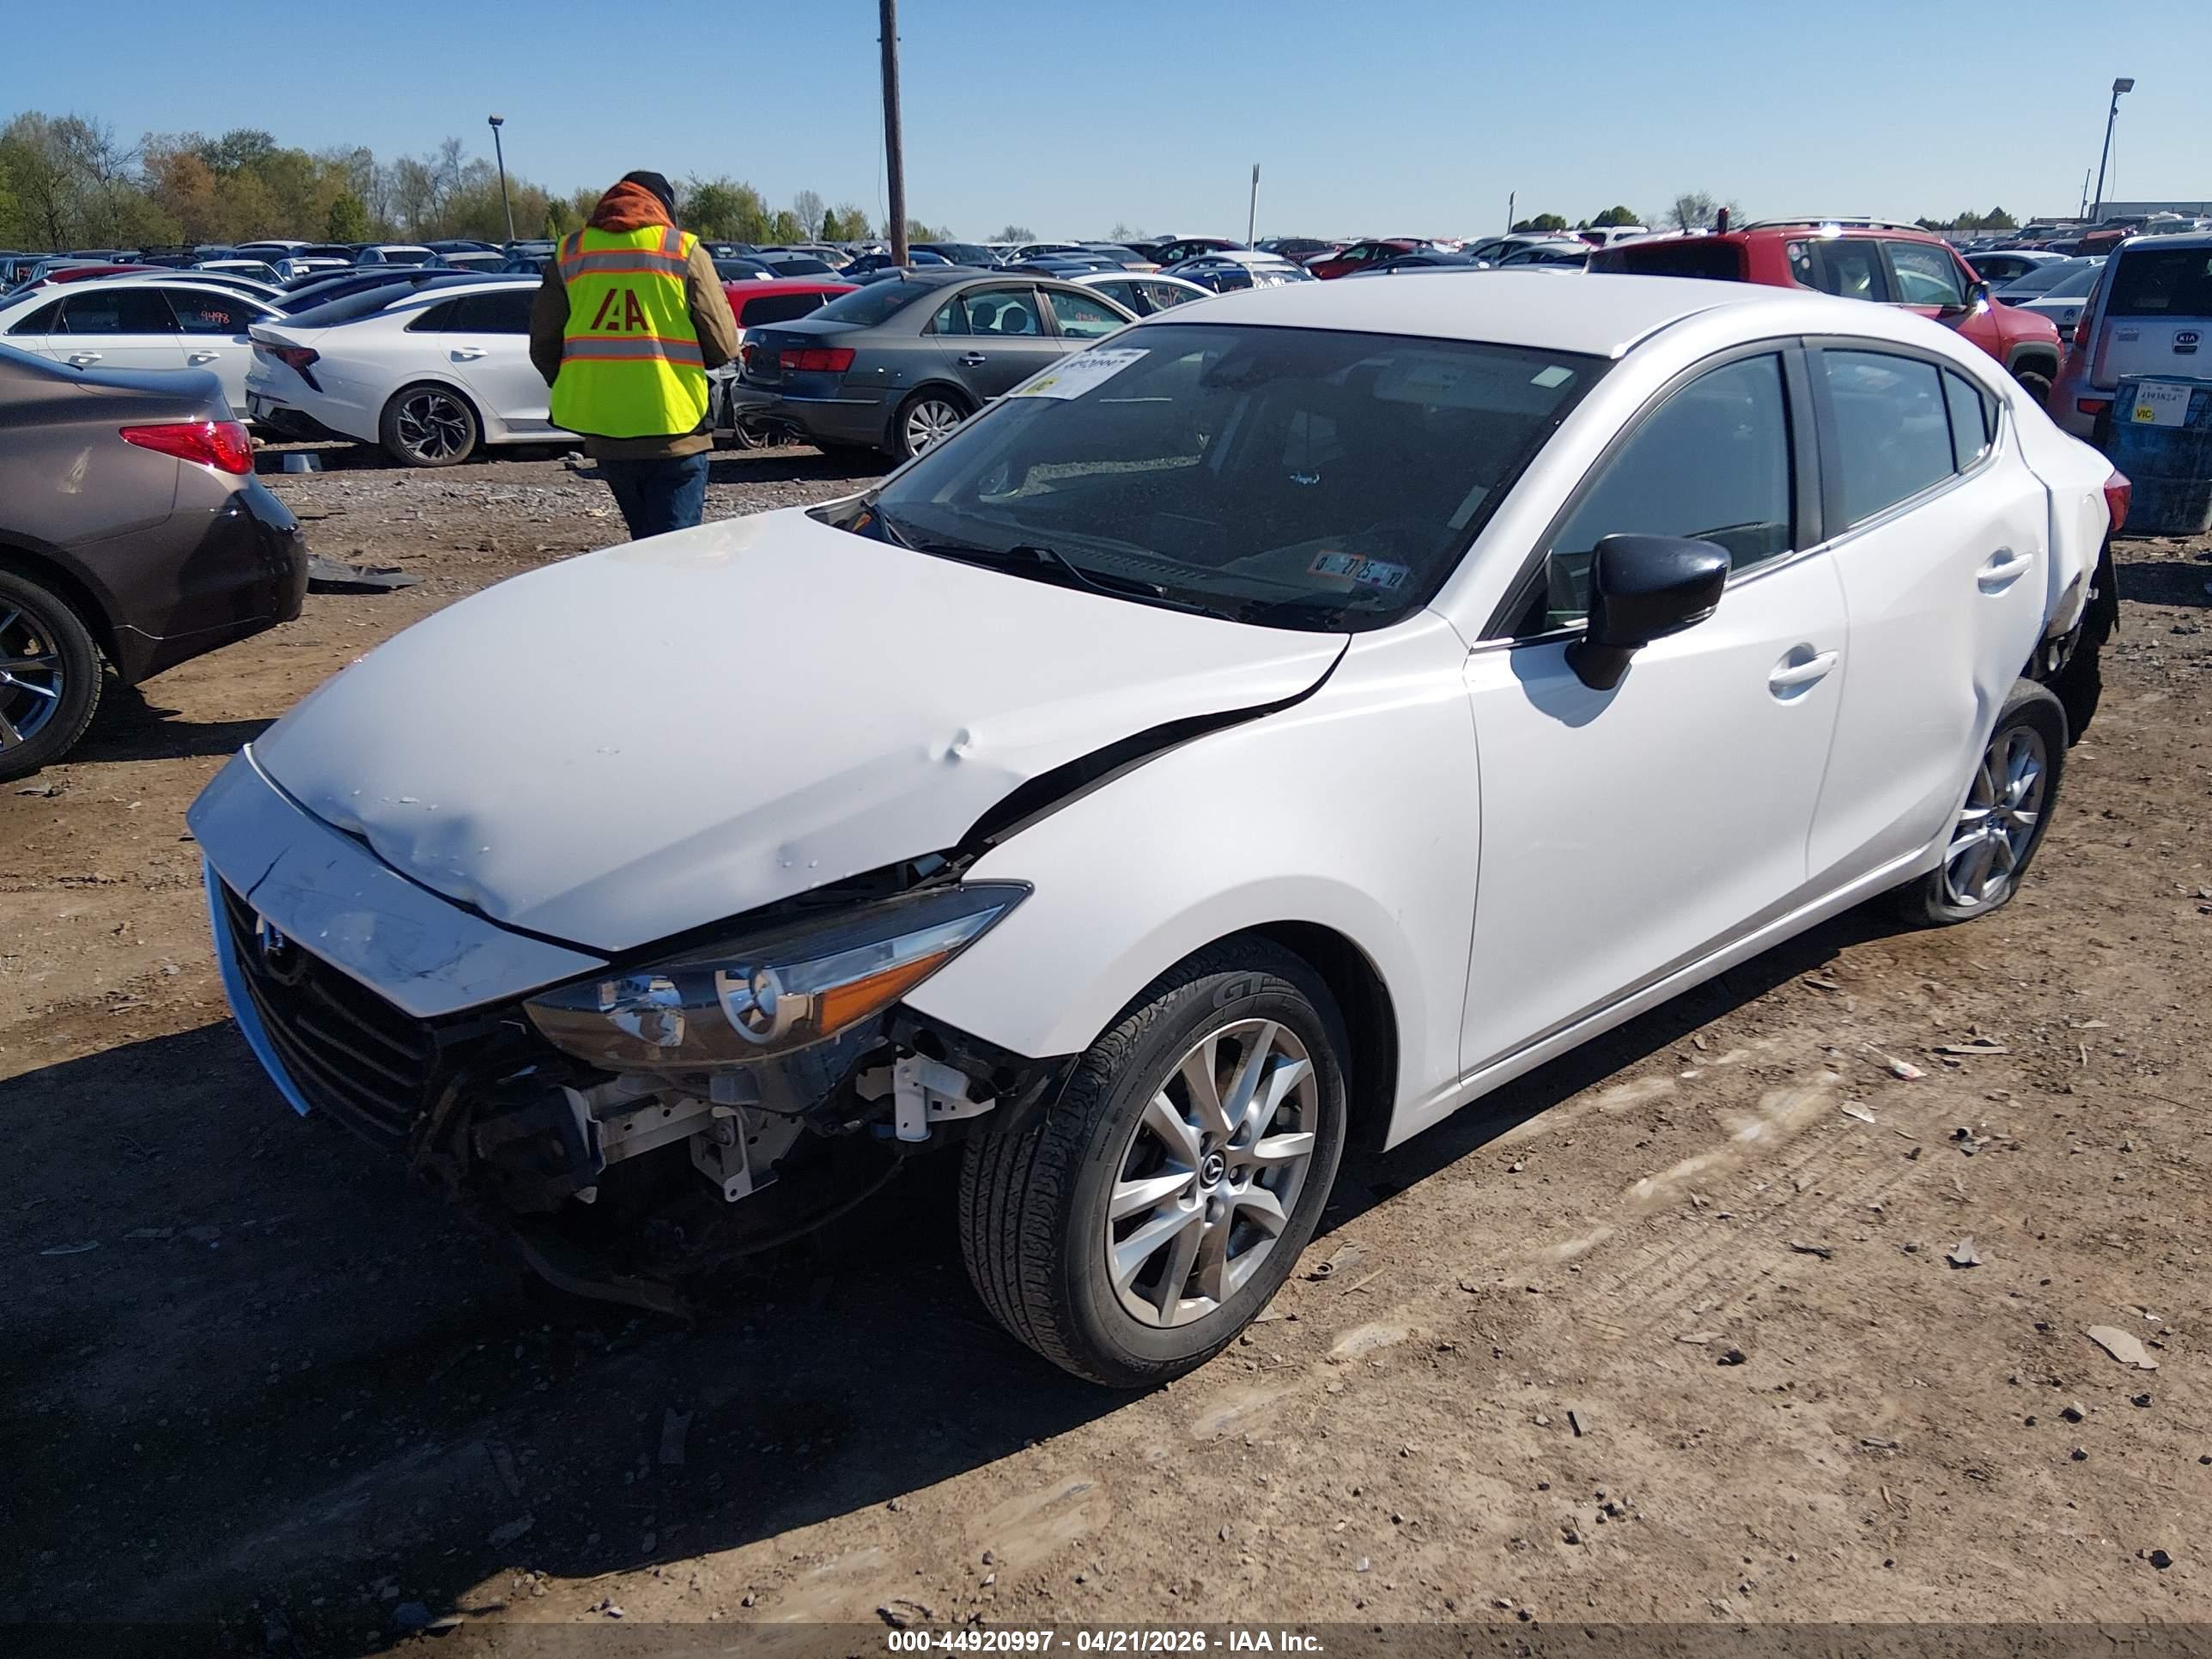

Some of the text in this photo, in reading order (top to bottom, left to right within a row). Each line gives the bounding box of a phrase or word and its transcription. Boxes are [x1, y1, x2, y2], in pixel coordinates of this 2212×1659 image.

[200, 309, 231, 324] 9498
[1356, 562, 1403, 586] 25 12
